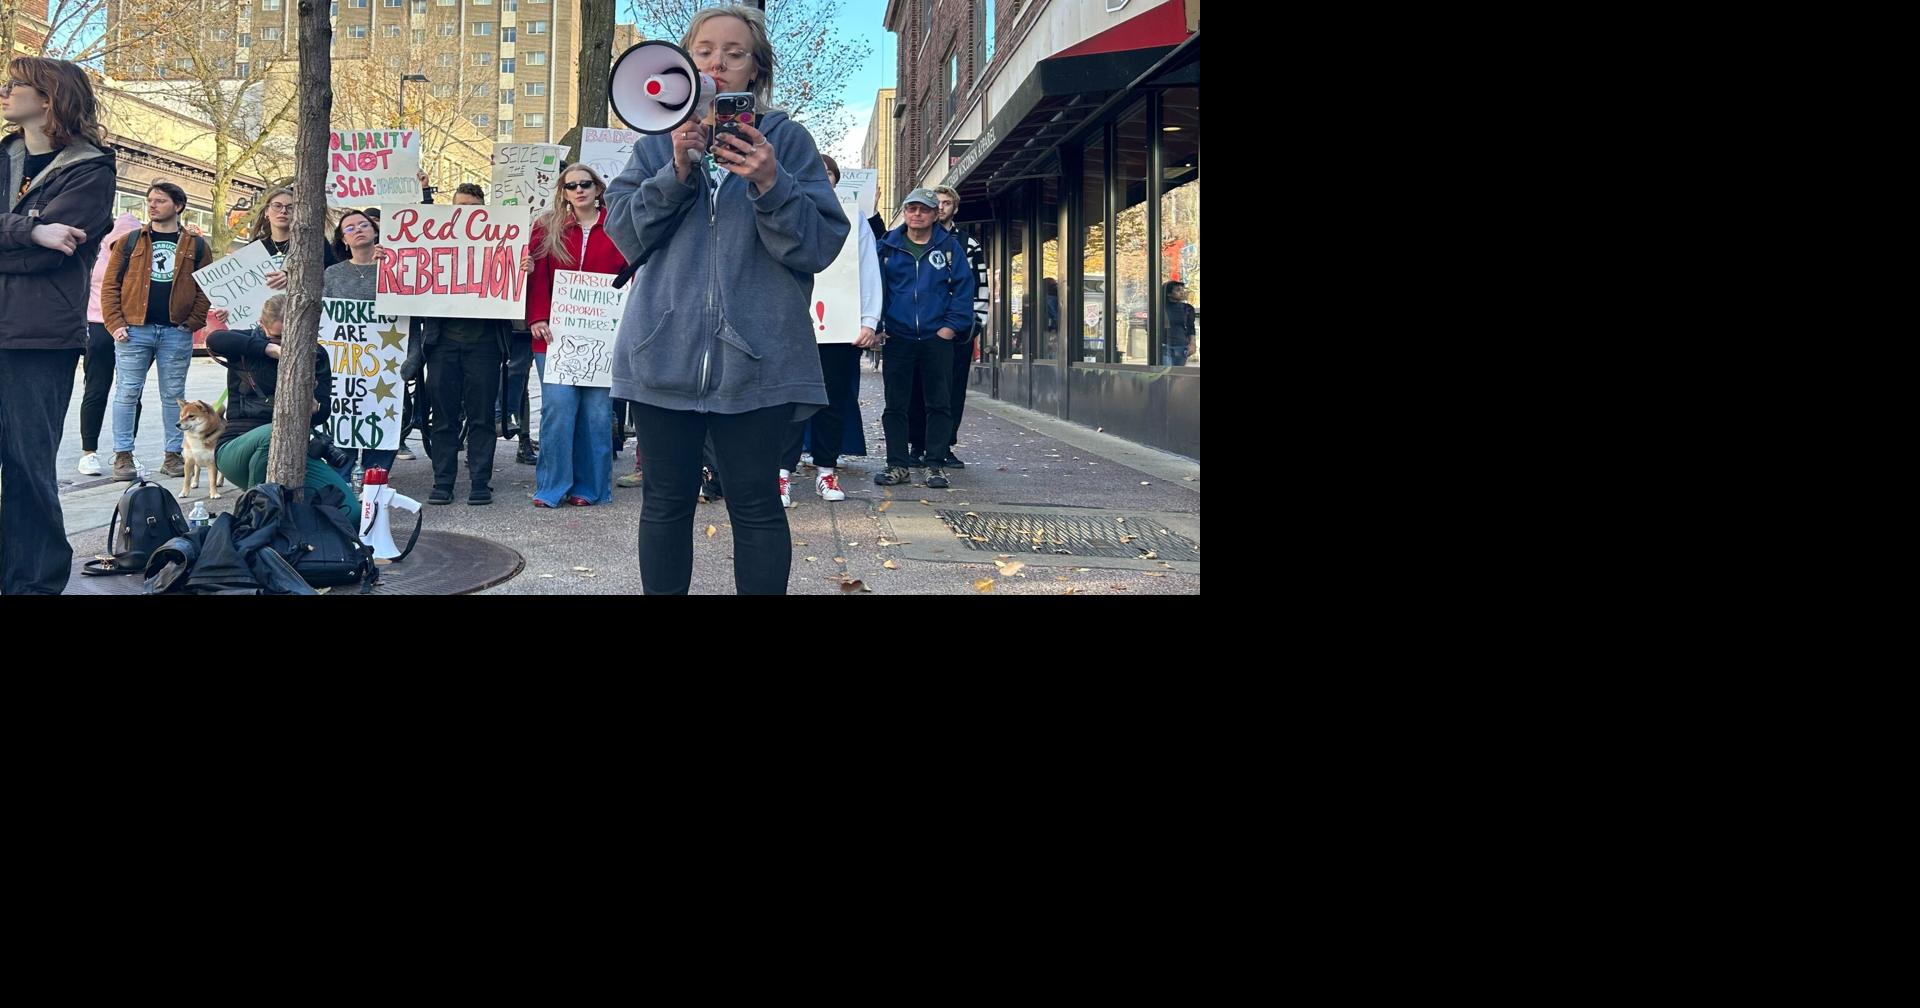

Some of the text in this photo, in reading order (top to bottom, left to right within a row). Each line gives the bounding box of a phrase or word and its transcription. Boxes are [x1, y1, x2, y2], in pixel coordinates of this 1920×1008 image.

[330, 131, 412, 151] OLIDARITY
[331, 149, 393, 172] NOT
[499, 147, 539, 164] SEIZE
[509, 165, 526, 173] THE
[495, 179, 550, 199] BEANS
[387, 207, 520, 250] Red Cup
[378, 245, 529, 302] REBELLION
[552, 301, 608, 318] CORPORATE
[552, 316, 560, 325] IS
[333, 325, 367, 342] ARE
[318, 340, 380, 377] TARS
[345, 378, 367, 398] US
[330, 397, 363, 415] ORE
